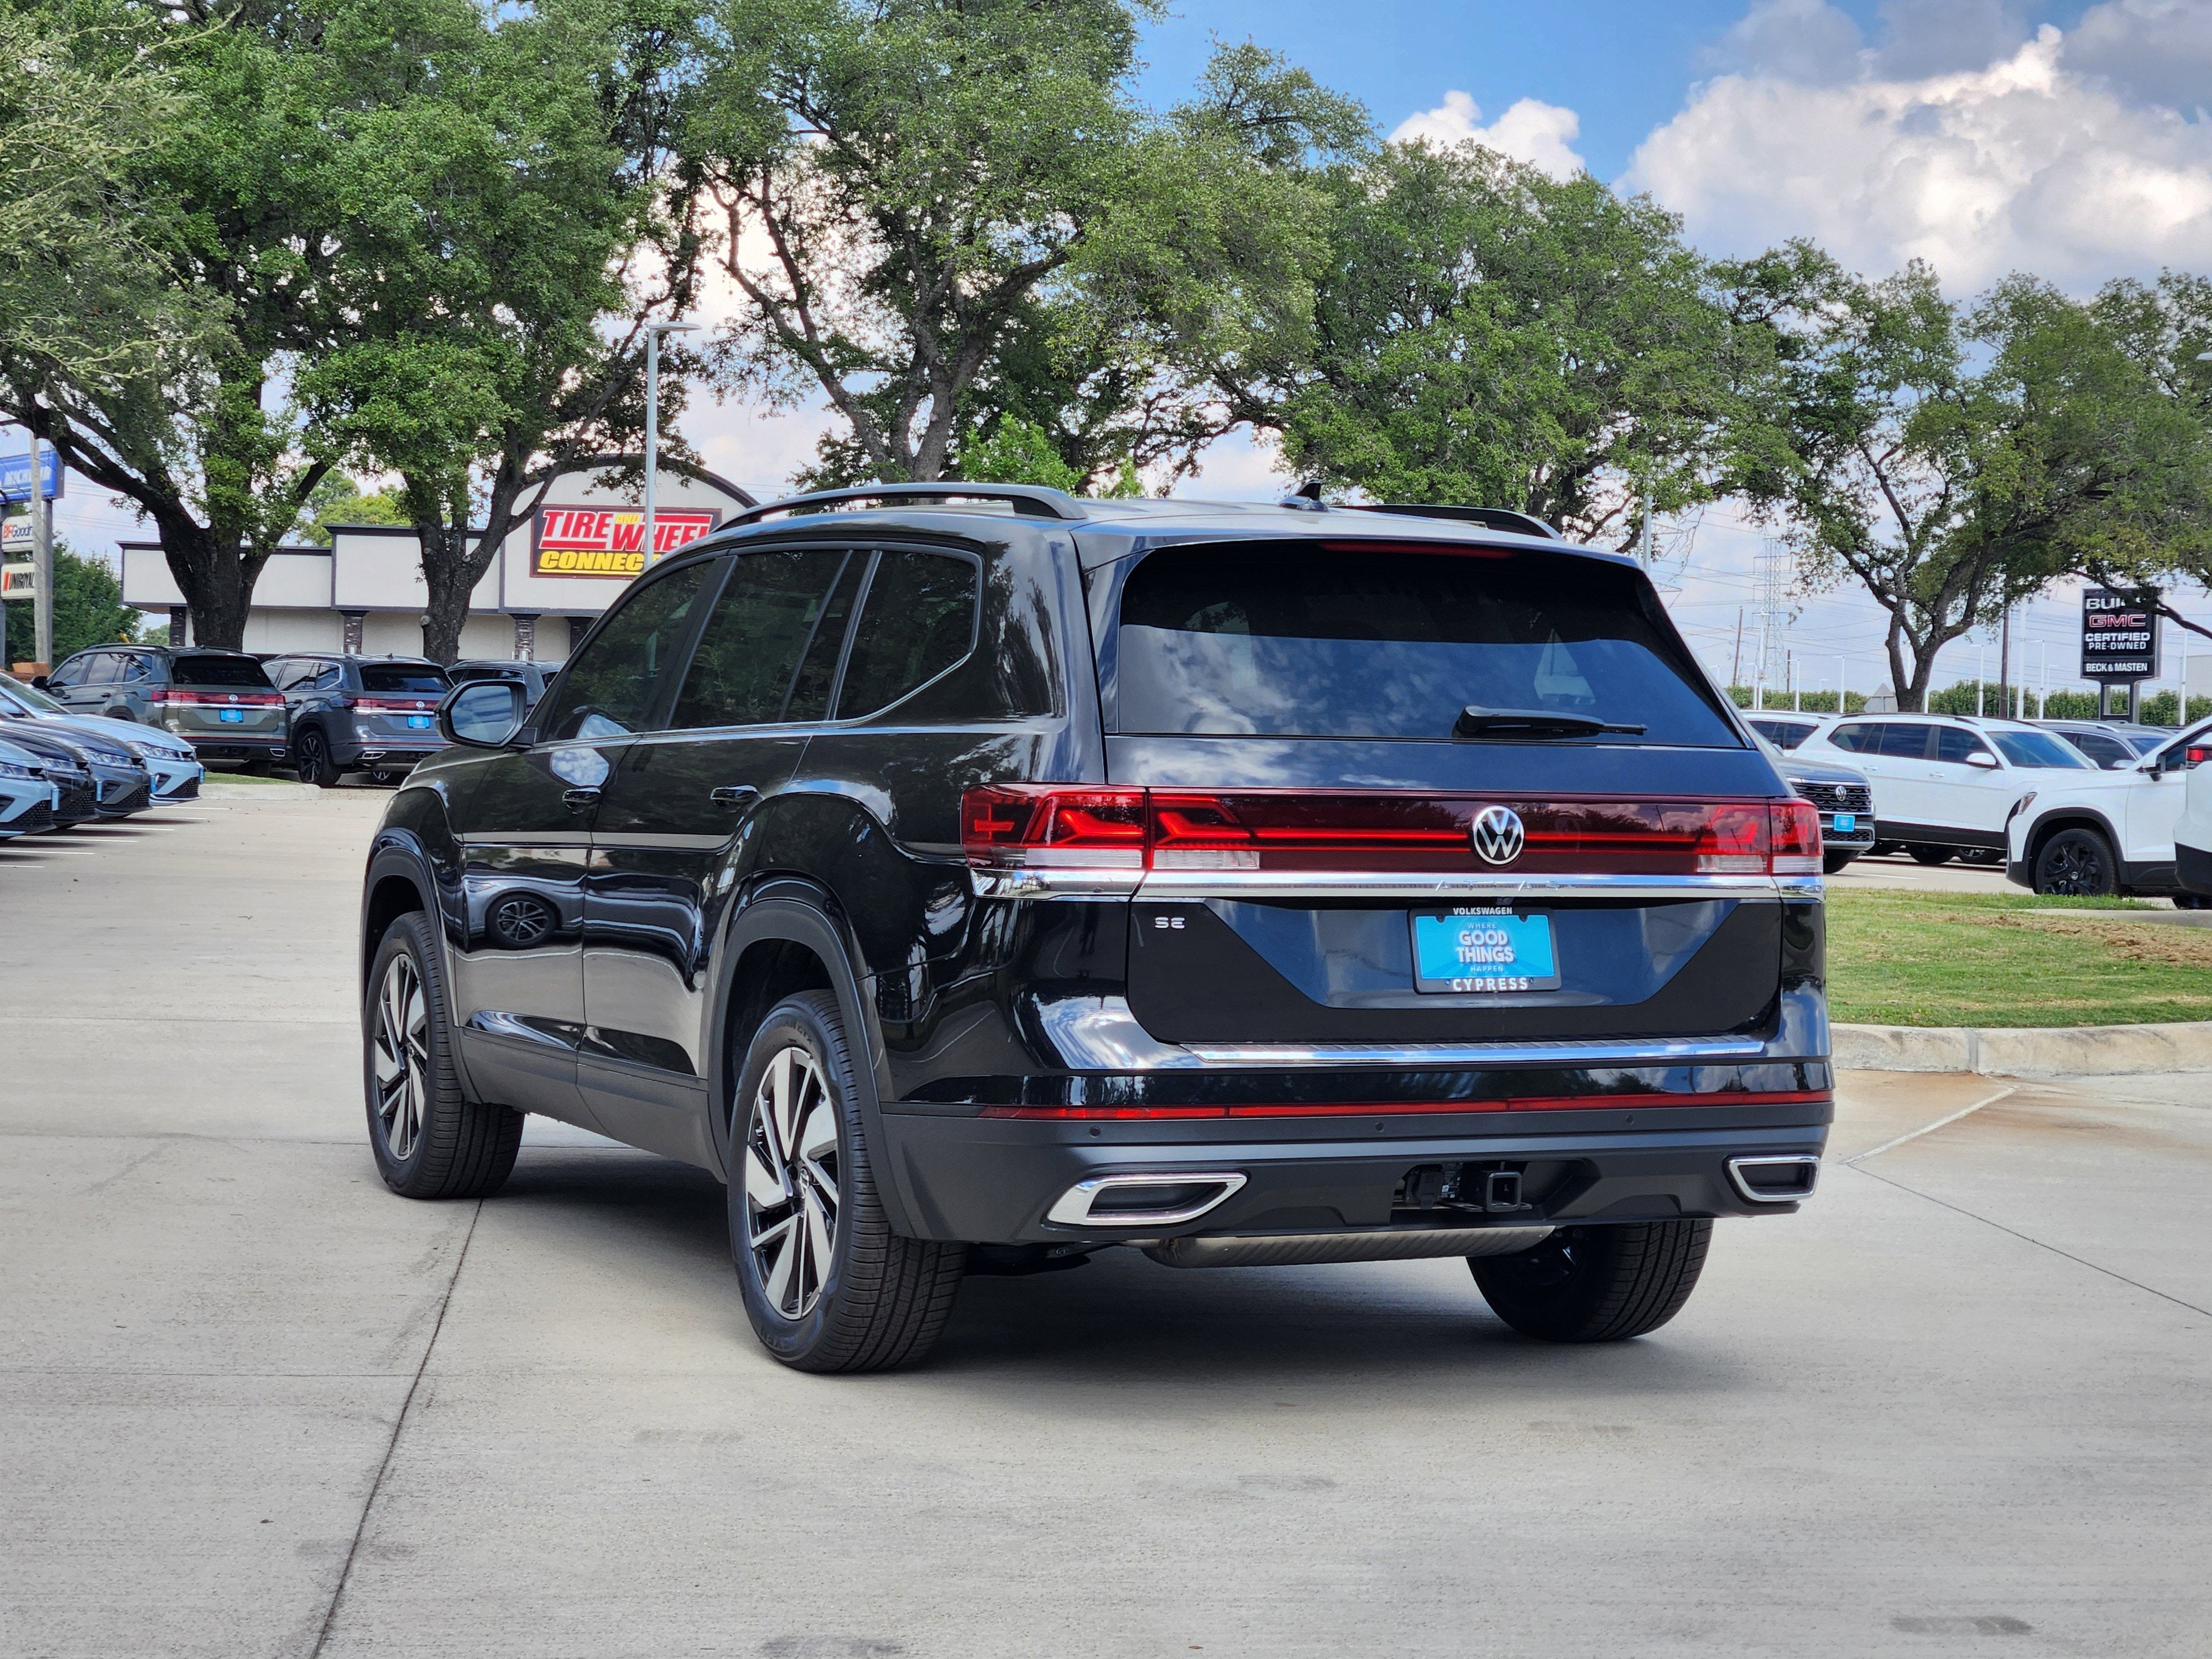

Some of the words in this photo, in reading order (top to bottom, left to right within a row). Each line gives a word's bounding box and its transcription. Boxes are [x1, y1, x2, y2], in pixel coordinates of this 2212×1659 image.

[544, 510, 614, 539] TIRE
[615, 513, 640, 525] AND
[539, 551, 662, 571] CONNEC
[2086, 597, 2147, 609] BUI
[2089, 614, 2147, 628] GMC
[2085, 632, 2151, 642] CERTIFIED
[2089, 641, 2147, 650] PRE-OWNED
[2086, 663, 2107, 672] BECK
[2107, 664, 2114, 672] &
[2115, 662, 2148, 672] MASTEN
[1453, 907, 1513, 915] VOLKSWAGEN
[1155, 917, 1185, 929] SE
[1458, 930, 1509, 946] GOOD
[1456, 946, 1516, 964] THINGS
[1452, 977, 1529, 992] CYPRESS
